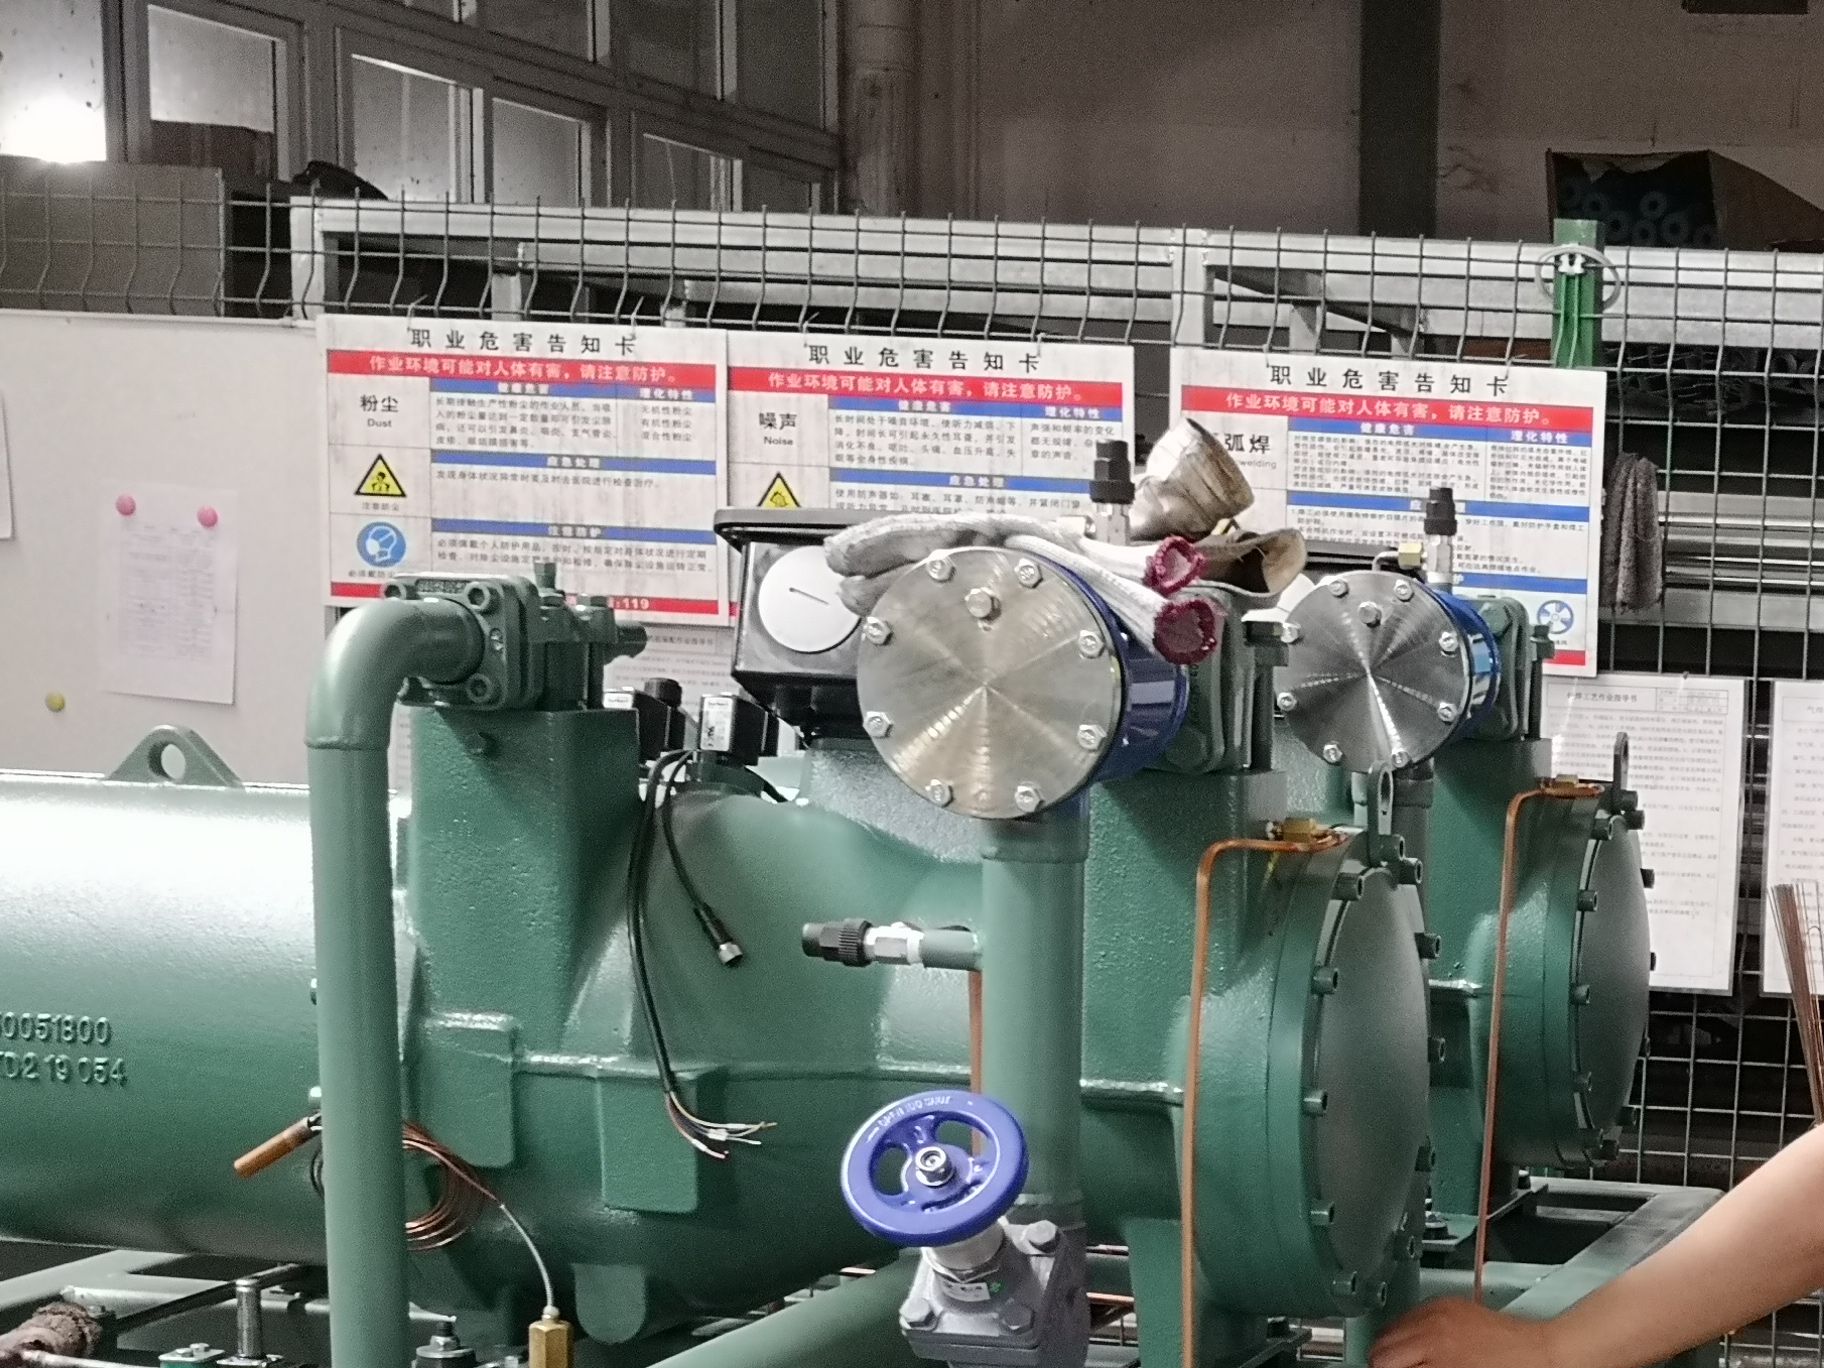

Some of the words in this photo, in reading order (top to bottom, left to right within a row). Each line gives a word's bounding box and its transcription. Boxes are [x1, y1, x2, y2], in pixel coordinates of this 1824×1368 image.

[411, 328, 637, 356] 职业危害告知卡
[808, 344, 1040, 374] 职业危害告知卡
[1270, 364, 1509, 395] 职业危害告知卡
[359, 394, 400, 414] 粉尘
[1225, 392, 1551, 426] 作业环境可能对人体有害，请注意防护。
[367, 418, 393, 429] Dust
[758, 412, 798, 431] 噪声
[763, 435, 794, 447] Noise
[1213, 432, 1271, 454] 弧焊
